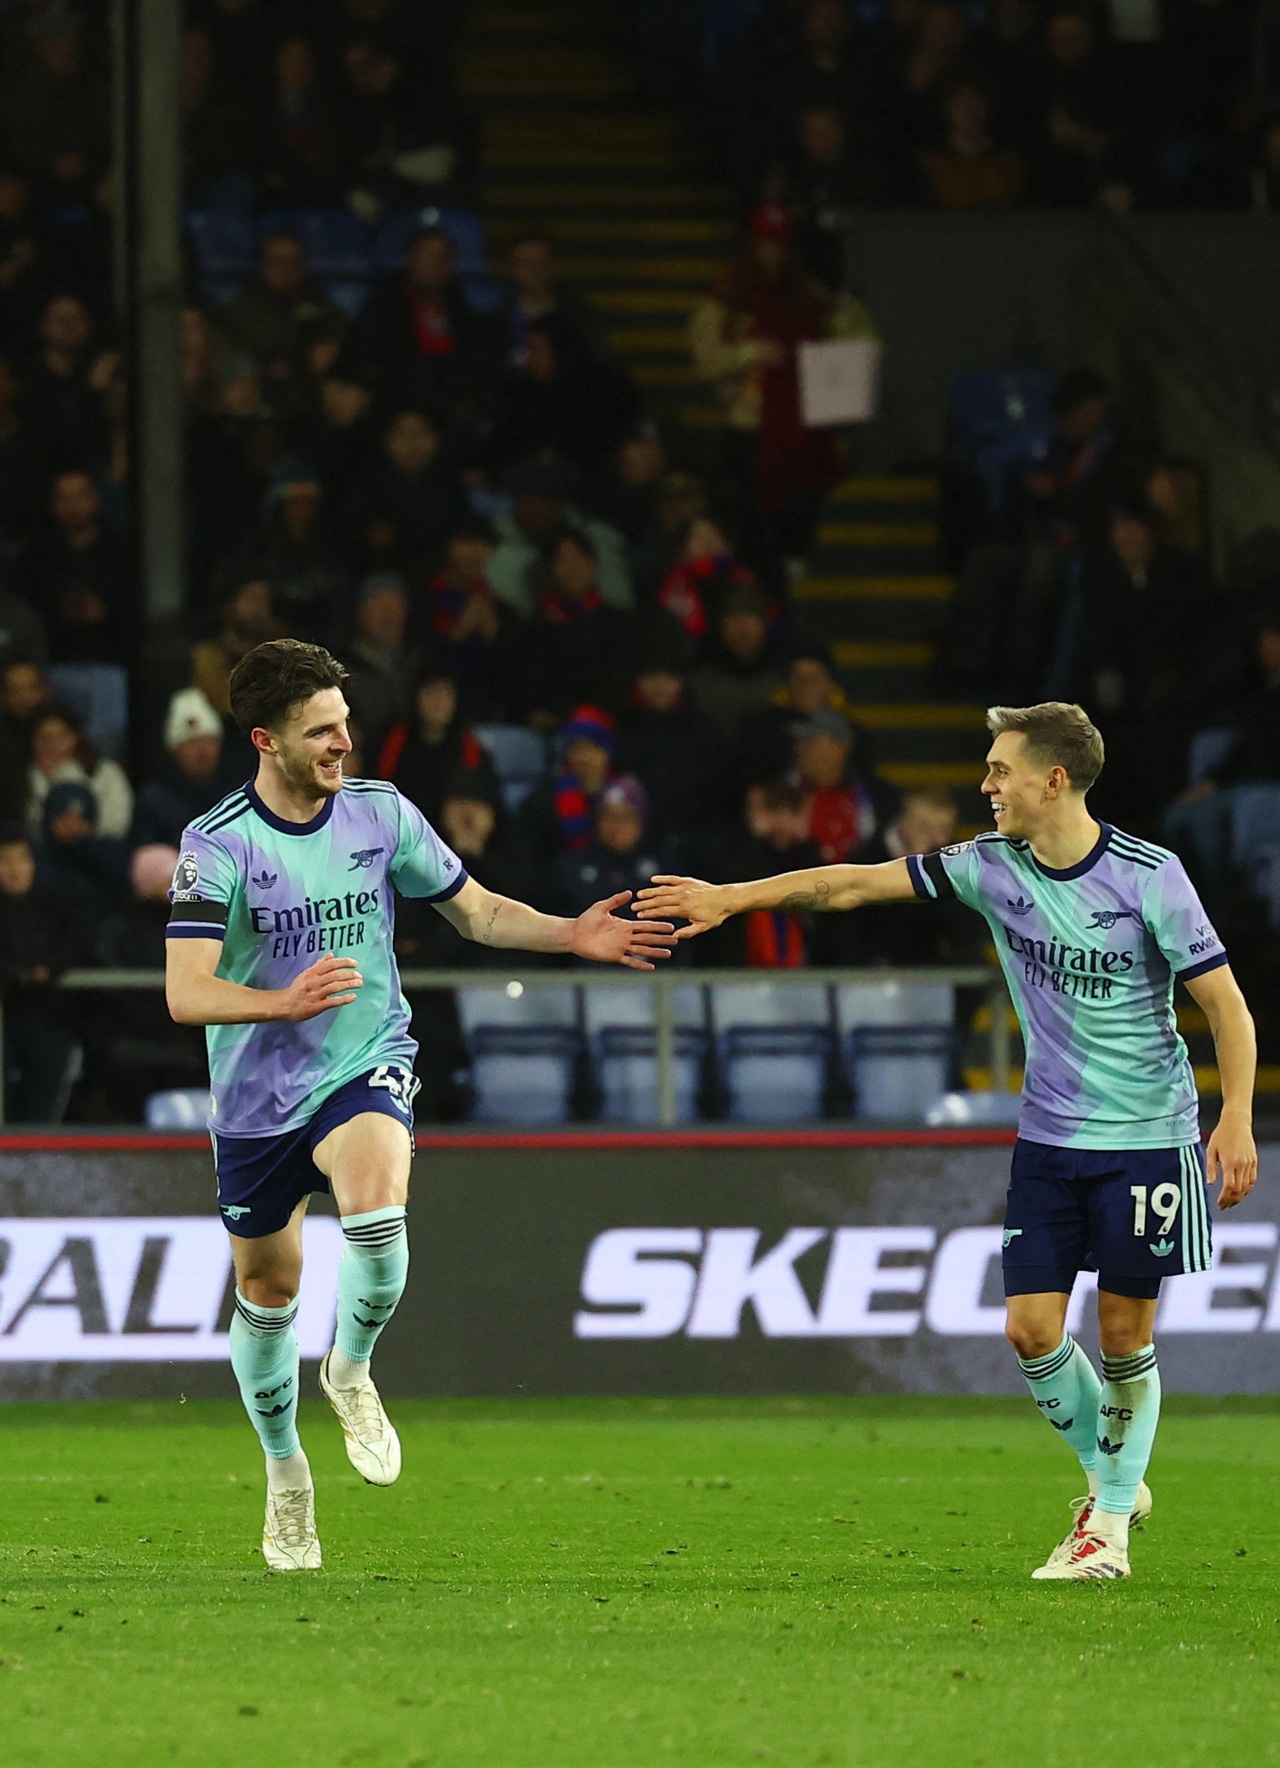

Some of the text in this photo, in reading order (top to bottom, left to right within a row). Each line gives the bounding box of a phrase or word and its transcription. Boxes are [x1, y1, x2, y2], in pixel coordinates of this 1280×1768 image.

[250, 888, 379, 934] Emirates
[273, 921, 365, 959] FLY BETTER
[1002, 925, 1134, 974] Emirates
[1025, 961, 1113, 999] FLY BETTER
[1131, 1182, 1182, 1237] 19
[254, 1377, 294, 1399] AFC
[1100, 1404, 1134, 1422] AFC
